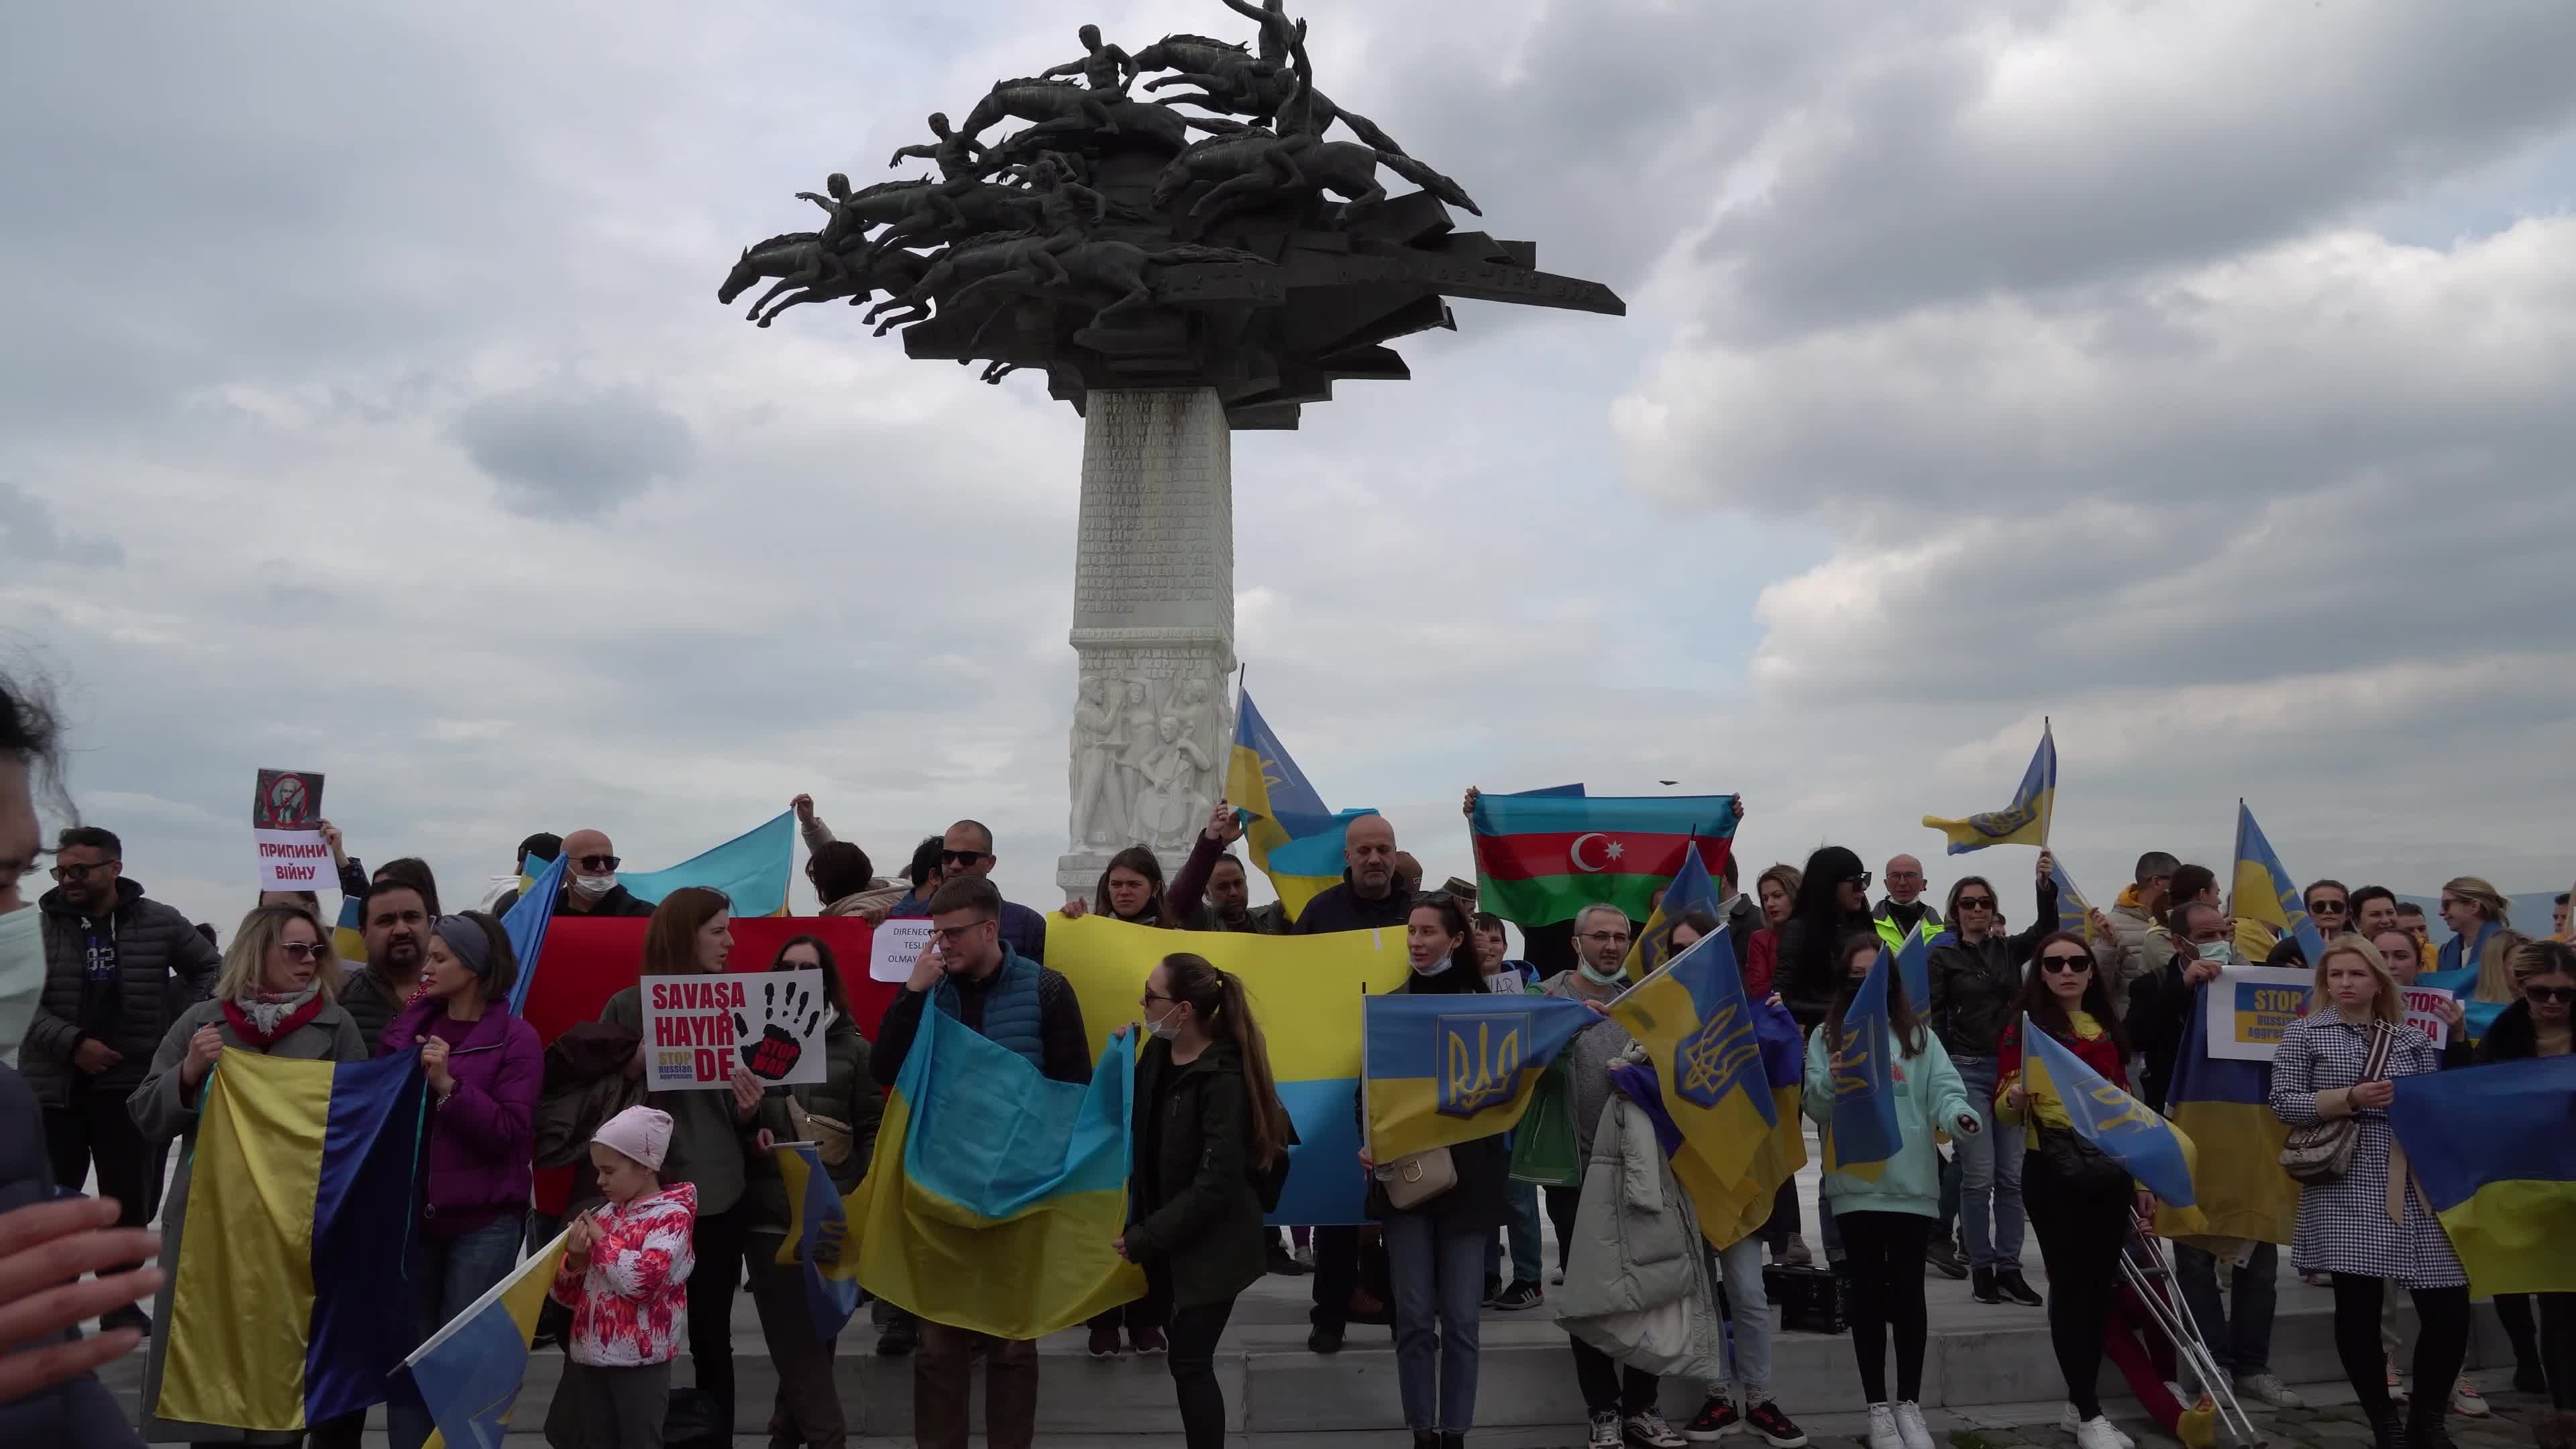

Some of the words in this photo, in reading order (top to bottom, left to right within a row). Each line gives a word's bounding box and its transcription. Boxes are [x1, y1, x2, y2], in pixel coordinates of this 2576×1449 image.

[259, 843, 328, 859] ПРИПИНИ
[275, 863, 316, 880] ВІЙНУ
[893, 928, 932, 936] DIRENEC
[904, 941, 926, 949] TESLI
[888, 955, 918, 963] OLMAY
[653, 981, 746, 1016] SAVAŞA
[2255, 989, 2302, 1012] STOP
[655, 1015, 735, 1047] HAYIR
[659, 1051, 692, 1065] STOP
[761, 1036, 800, 1060] STOP
[694, 1048, 735, 1082] DE
[751, 1053, 788, 1077] WAR
